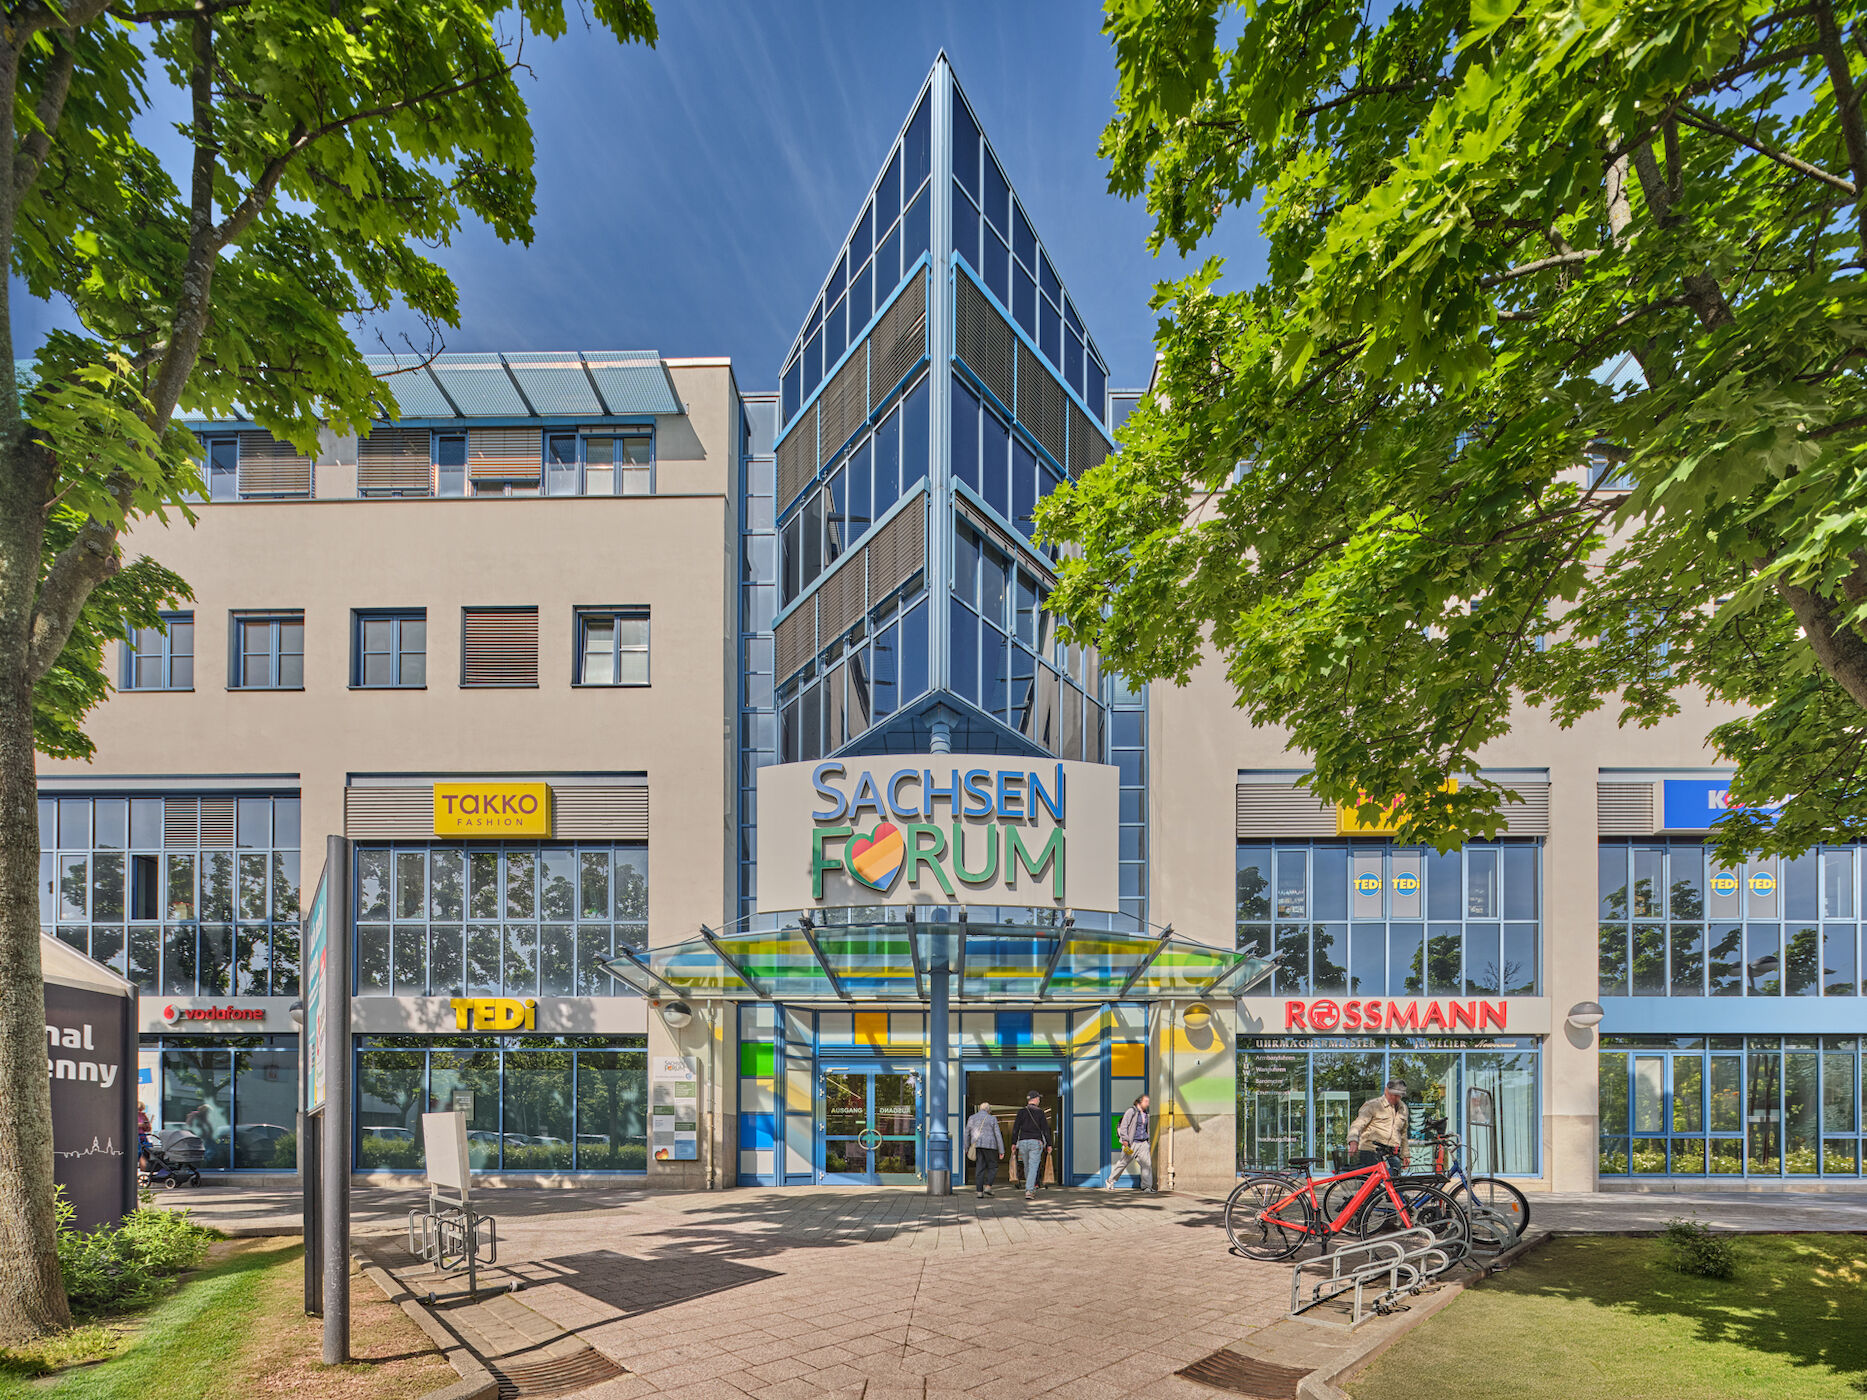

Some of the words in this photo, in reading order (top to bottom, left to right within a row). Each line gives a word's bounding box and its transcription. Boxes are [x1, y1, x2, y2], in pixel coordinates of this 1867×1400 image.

[812, 762, 1065, 821] SACHSEN
[457, 818, 523, 826] FASHION
[185, 1005, 266, 1020] vodafone
[450, 998, 537, 1031] TEDi
[1285, 999, 1508, 1030] ROSSMANN
[1391, 1039, 1400, 1048] &
